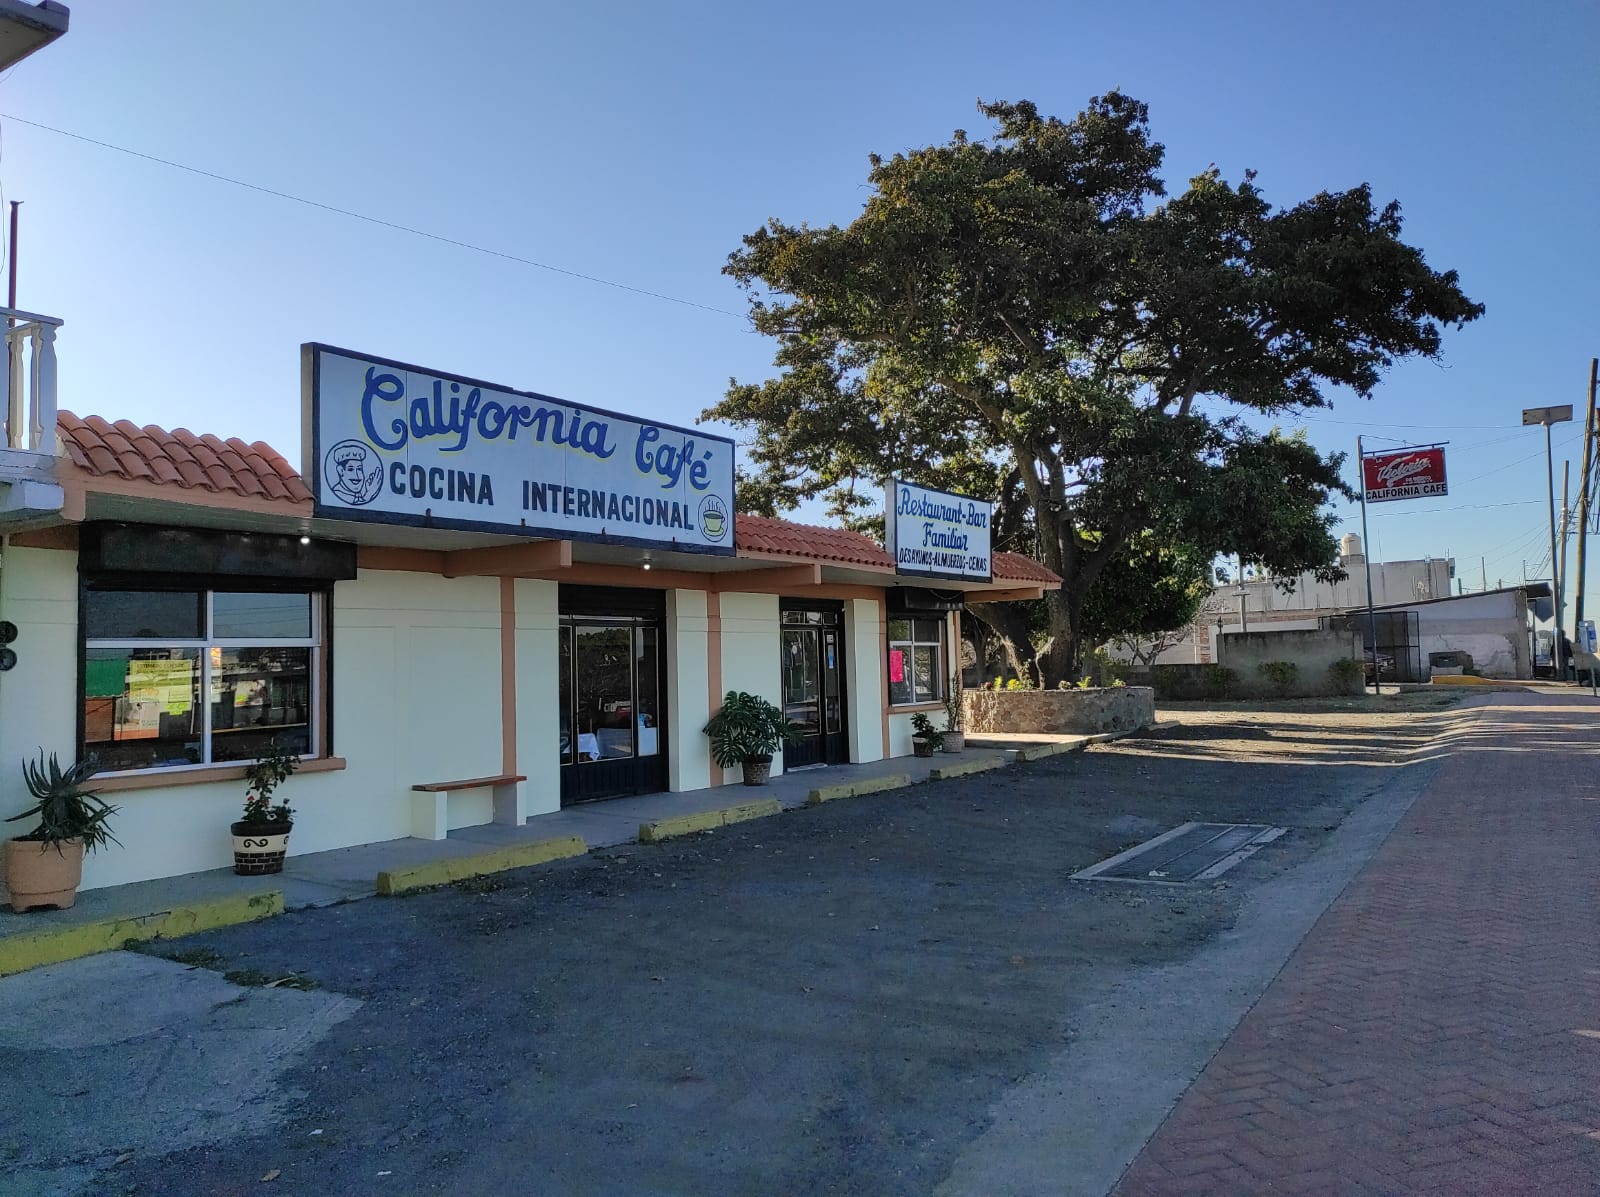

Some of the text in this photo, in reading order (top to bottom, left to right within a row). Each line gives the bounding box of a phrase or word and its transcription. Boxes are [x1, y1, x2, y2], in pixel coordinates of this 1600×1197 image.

[360, 366, 712, 491] California Café
[389, 461, 695, 530] COCINA INTERNACIONAL
[1366, 484, 1447, 499] CALIFORNIA CAFE
[922, 522, 969, 551] Familiar
